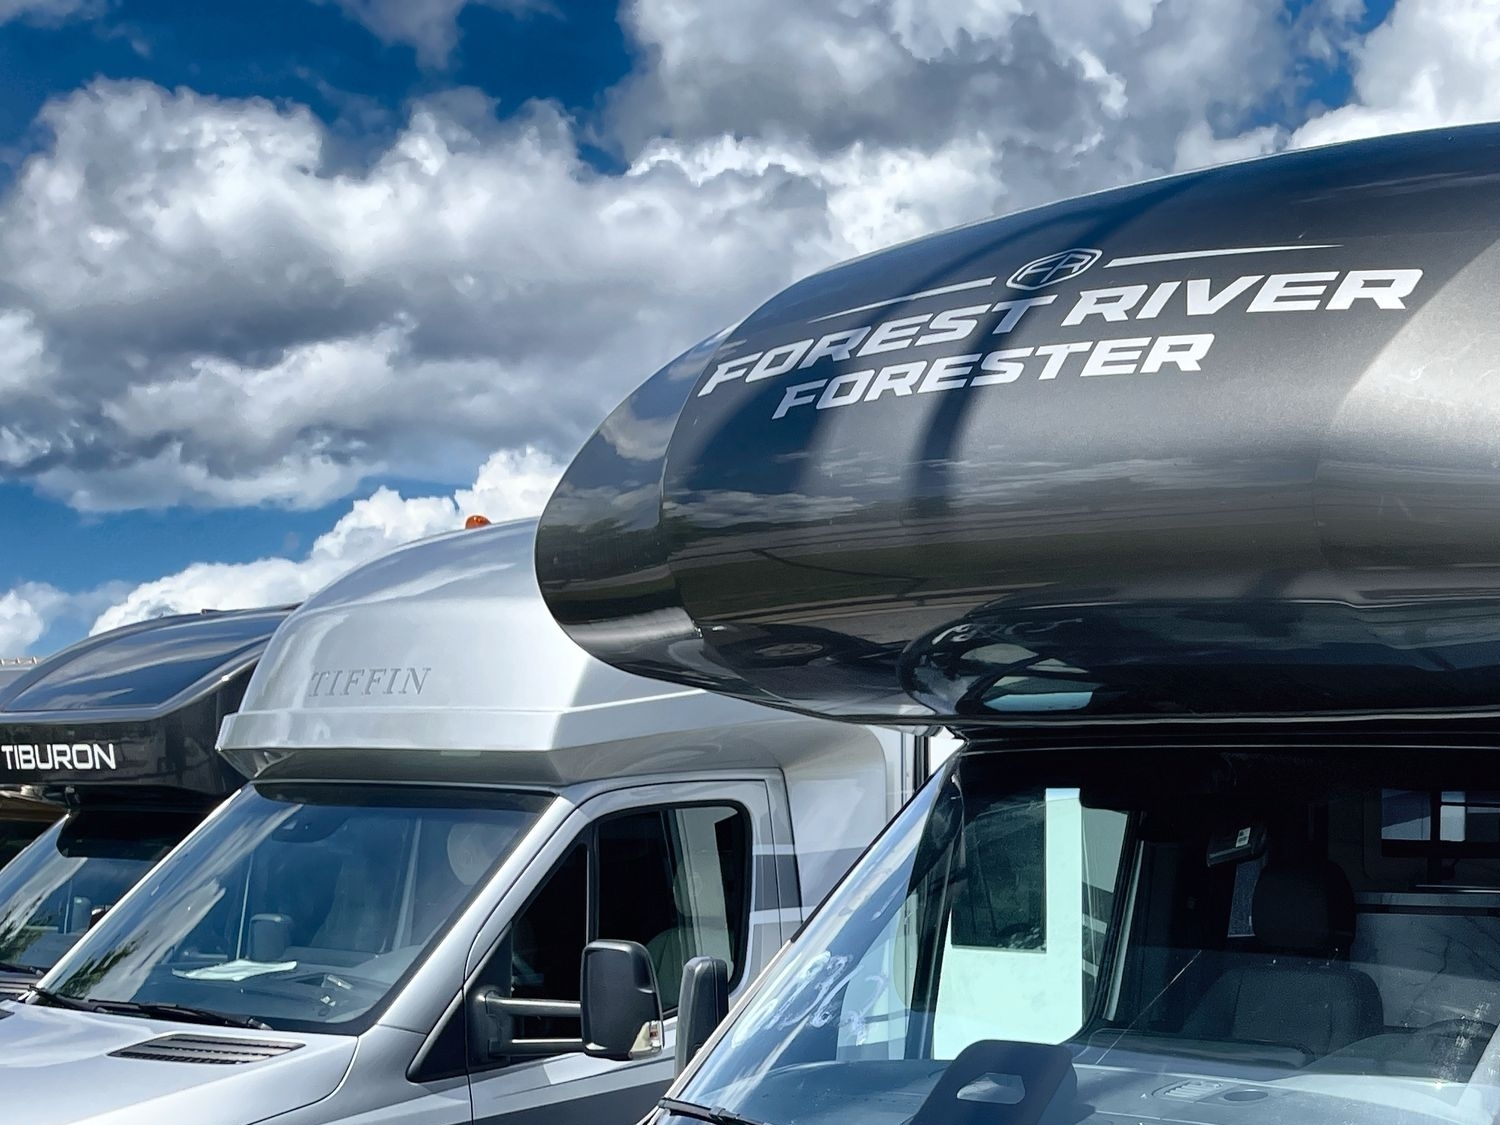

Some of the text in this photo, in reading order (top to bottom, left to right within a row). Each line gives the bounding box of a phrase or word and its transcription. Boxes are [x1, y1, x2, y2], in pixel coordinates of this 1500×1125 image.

[697, 268, 1424, 398] FOREST RIVER
[770, 332, 1216, 422] FORESTER
[308, 667, 431, 698] TIFFIN
[1, 743, 116, 770] TIBURON
